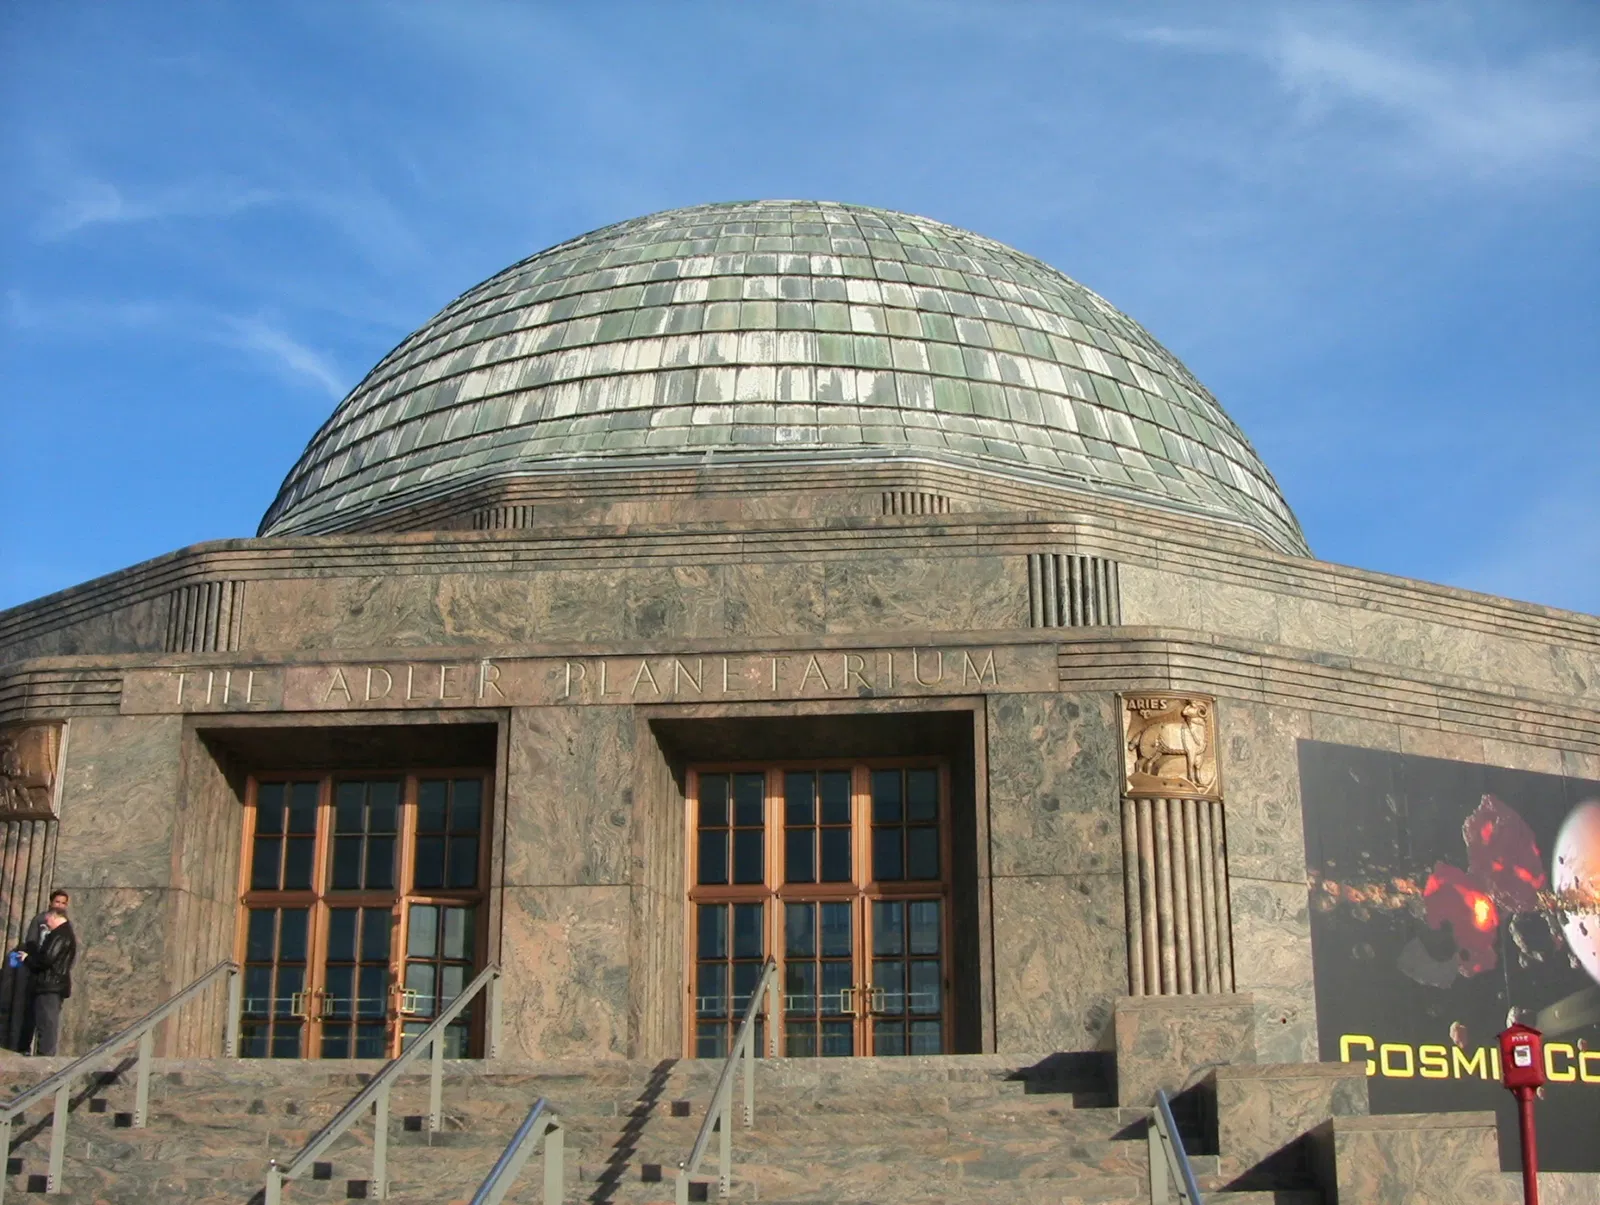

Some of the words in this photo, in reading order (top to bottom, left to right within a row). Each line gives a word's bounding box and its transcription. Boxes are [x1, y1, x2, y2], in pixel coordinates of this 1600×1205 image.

[169, 669, 269, 705] THE
[321, 663, 505, 703] ADLER
[564, 648, 1001, 697] PLANETARIUM
[1127, 699, 1168, 710] ARIES
[1340, 1034, 1500, 1080] COSMI
